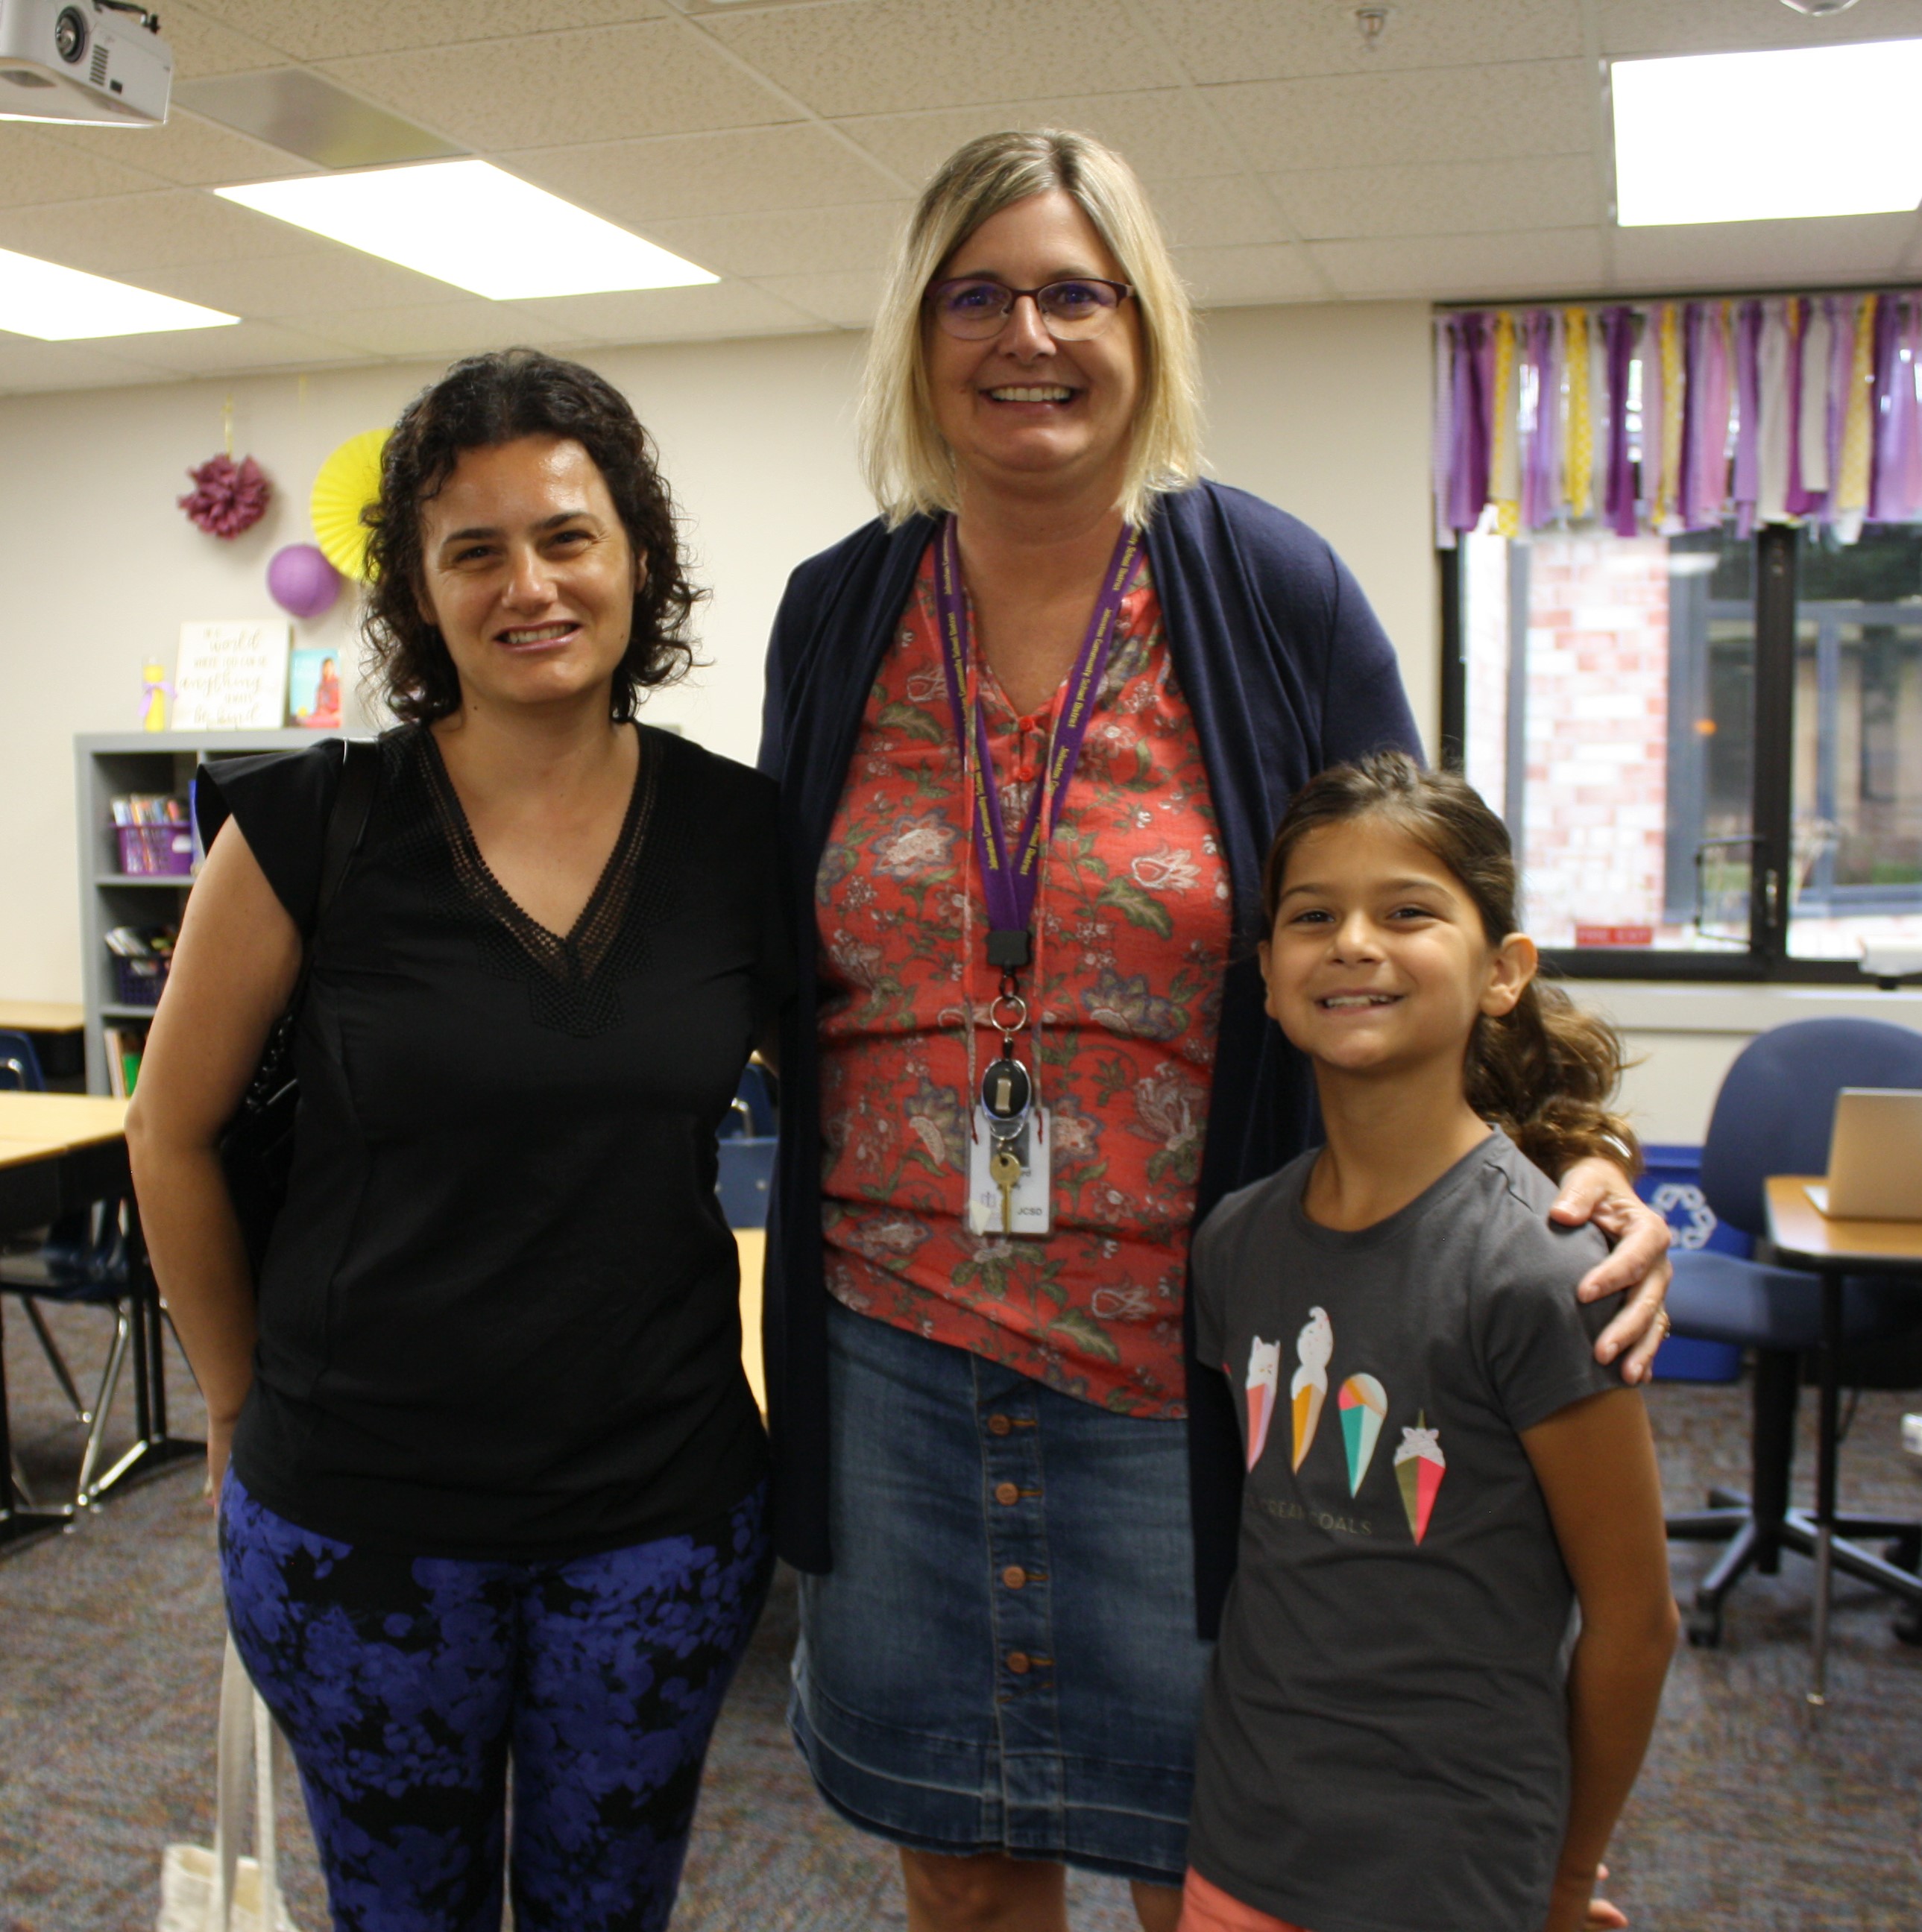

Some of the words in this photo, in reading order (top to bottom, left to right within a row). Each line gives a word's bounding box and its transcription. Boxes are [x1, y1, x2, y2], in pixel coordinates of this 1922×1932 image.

[1083, 638, 1103, 677] Community
[1076, 678, 1091, 701] School
[1067, 701, 1084, 728] District
[1053, 745, 1069, 779] Johnston
[1020, 847, 1036, 875] District
[1017, 1207, 1043, 1216] JCSD
